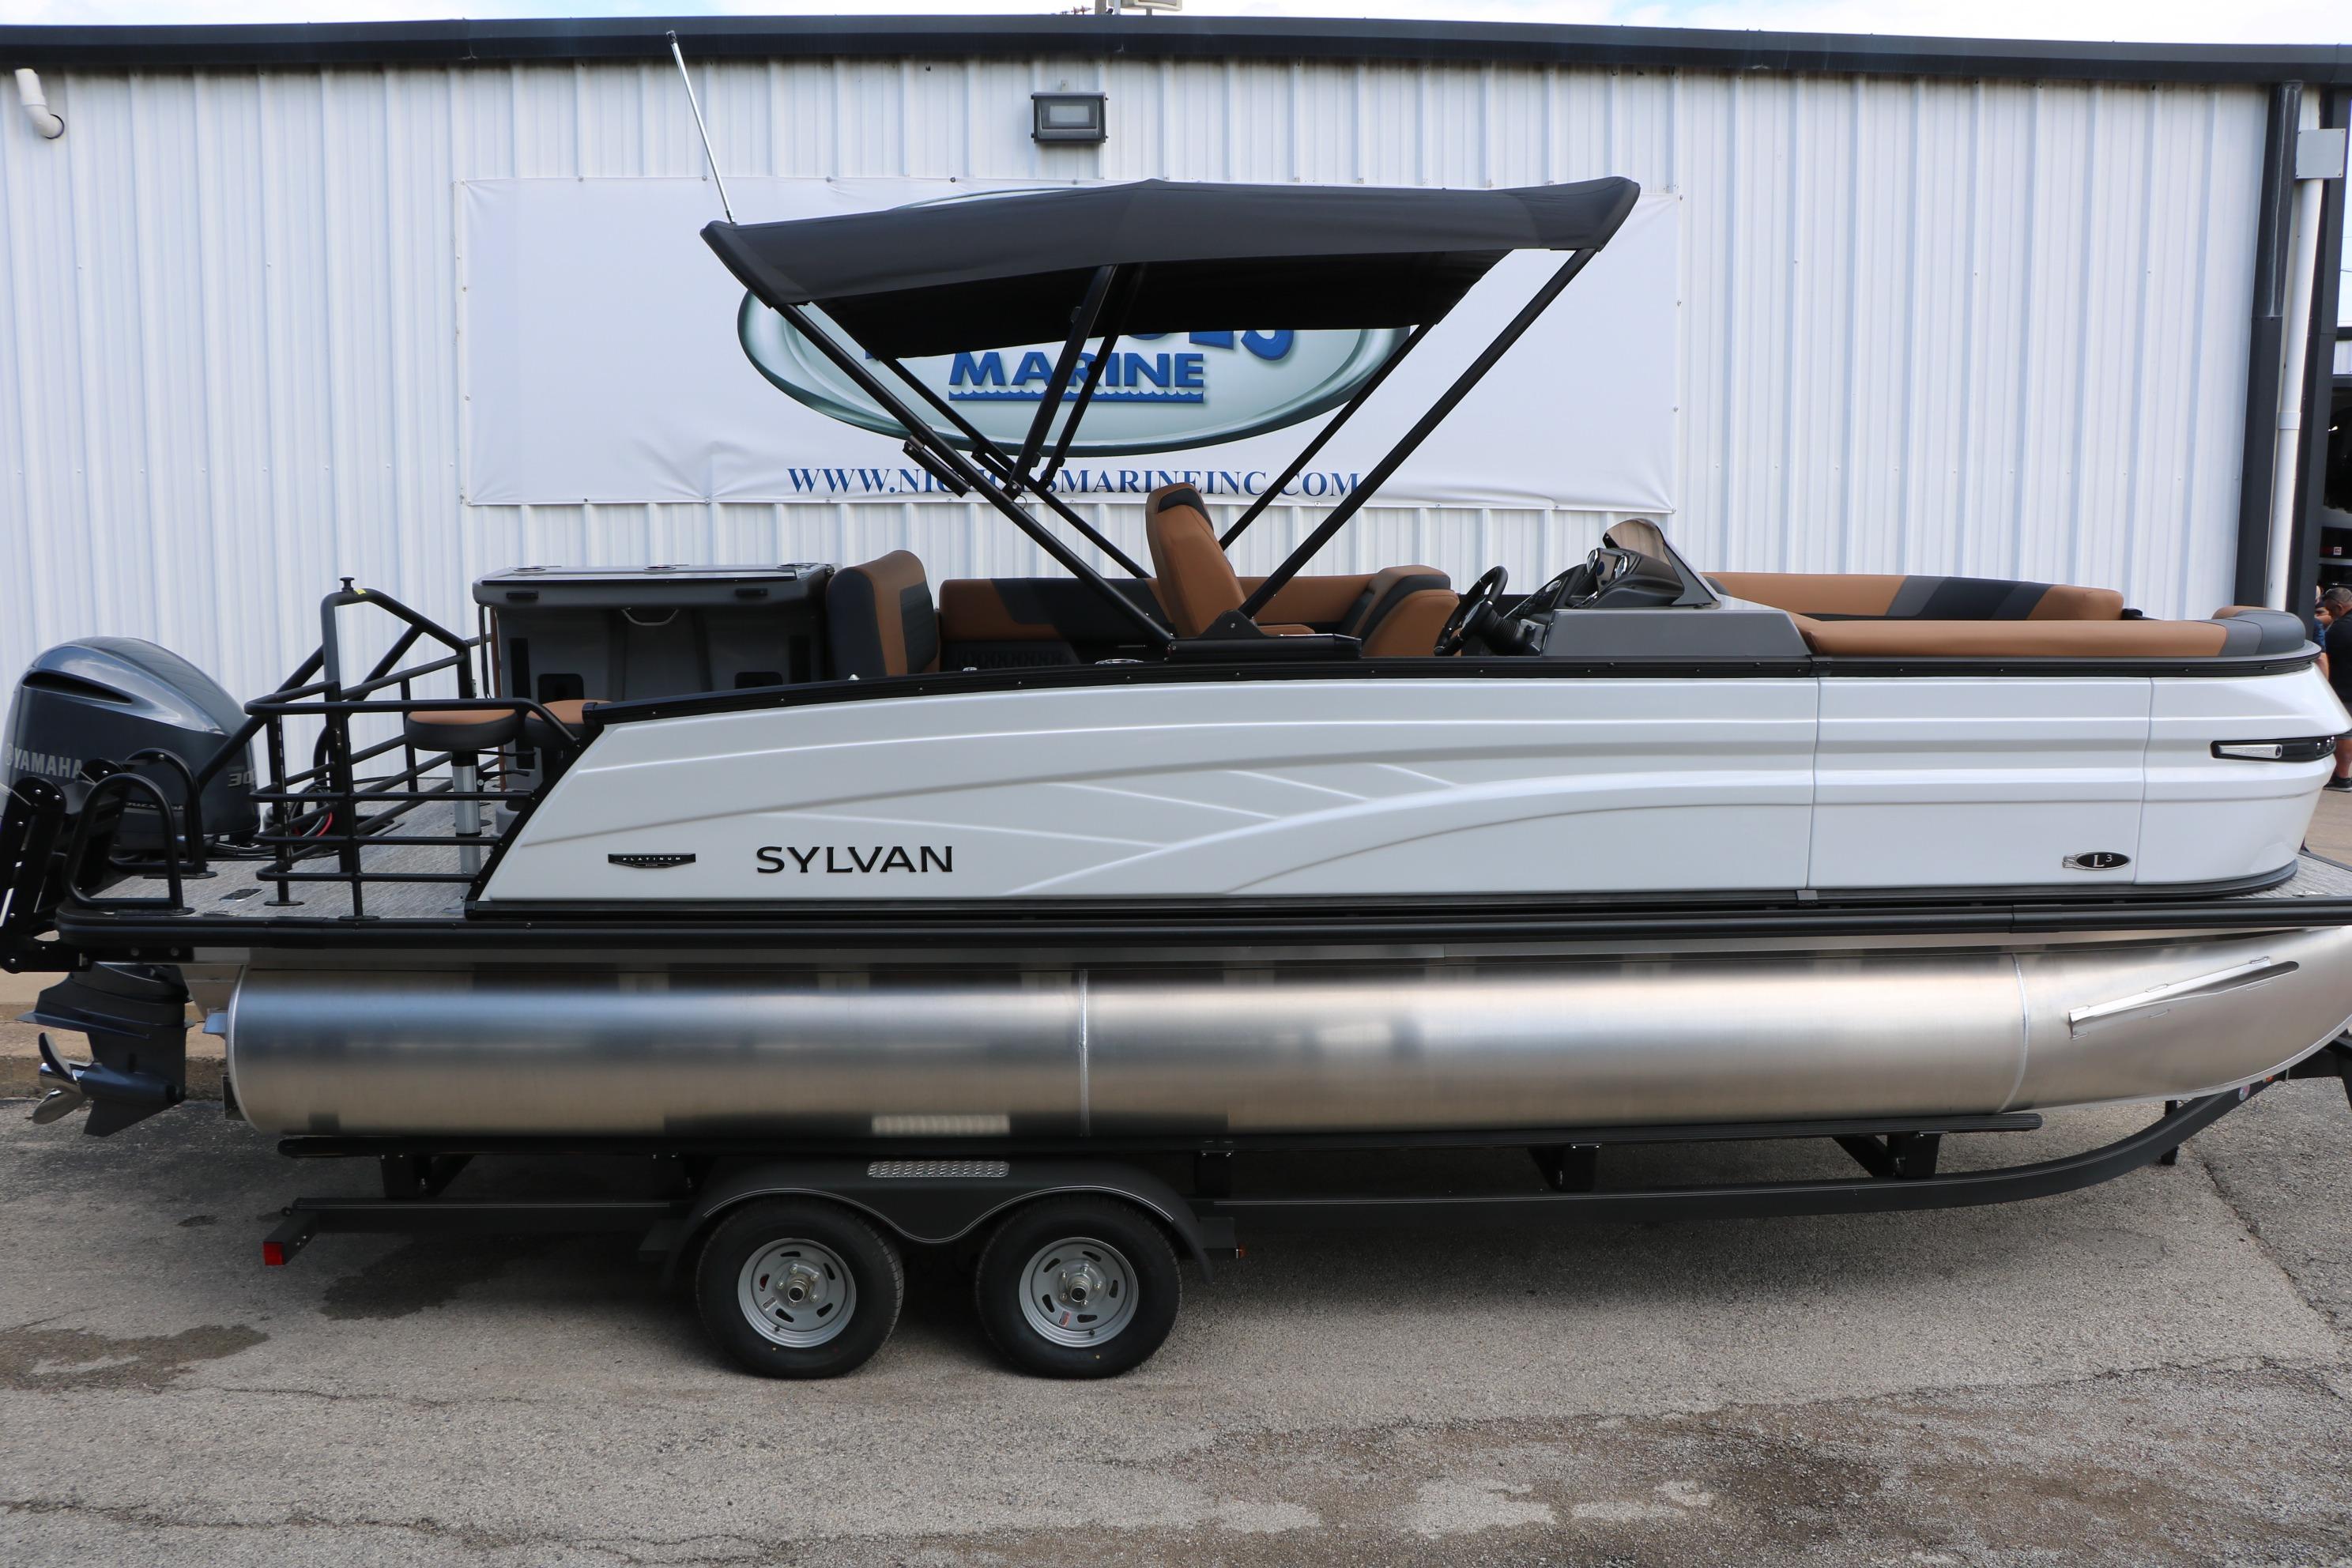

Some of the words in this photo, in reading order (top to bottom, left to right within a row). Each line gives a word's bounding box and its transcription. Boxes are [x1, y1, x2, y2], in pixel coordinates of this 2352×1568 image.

[948, 352, 1204, 388] MARINE
[14, 747, 82, 779] YAMAHA
[756, 846, 953, 873] SYLVAN
